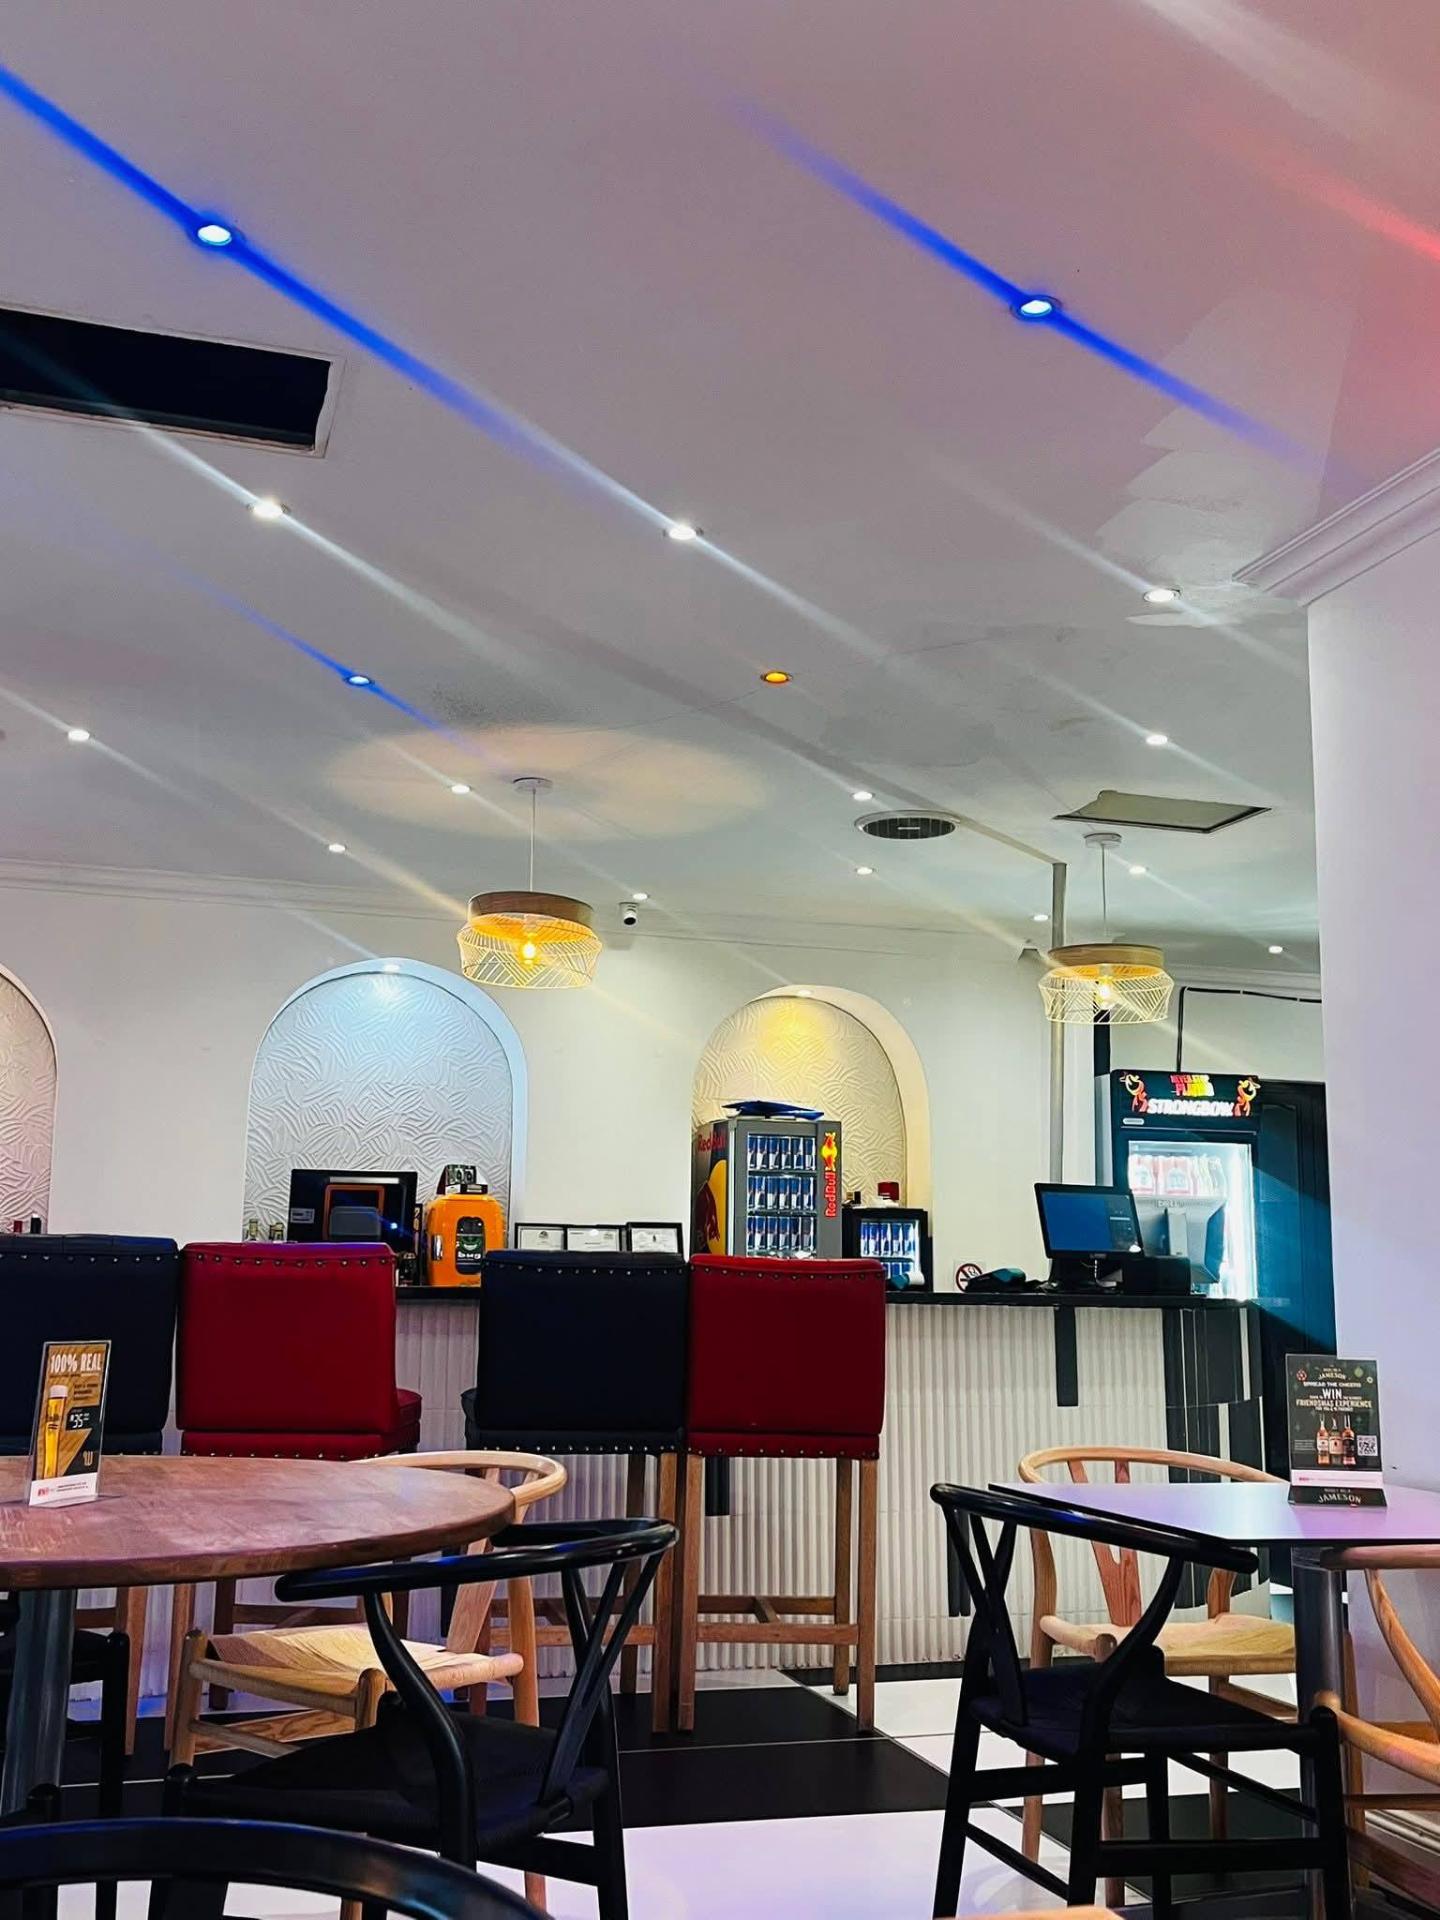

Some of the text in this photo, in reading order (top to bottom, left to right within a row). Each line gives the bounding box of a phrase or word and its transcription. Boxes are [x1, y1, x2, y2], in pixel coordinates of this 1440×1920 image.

[50, 1353, 102, 1374] 100% REAL
[1322, 1388, 1342, 1400] WIN
[1318, 1492, 1362, 1504] JAMESON
